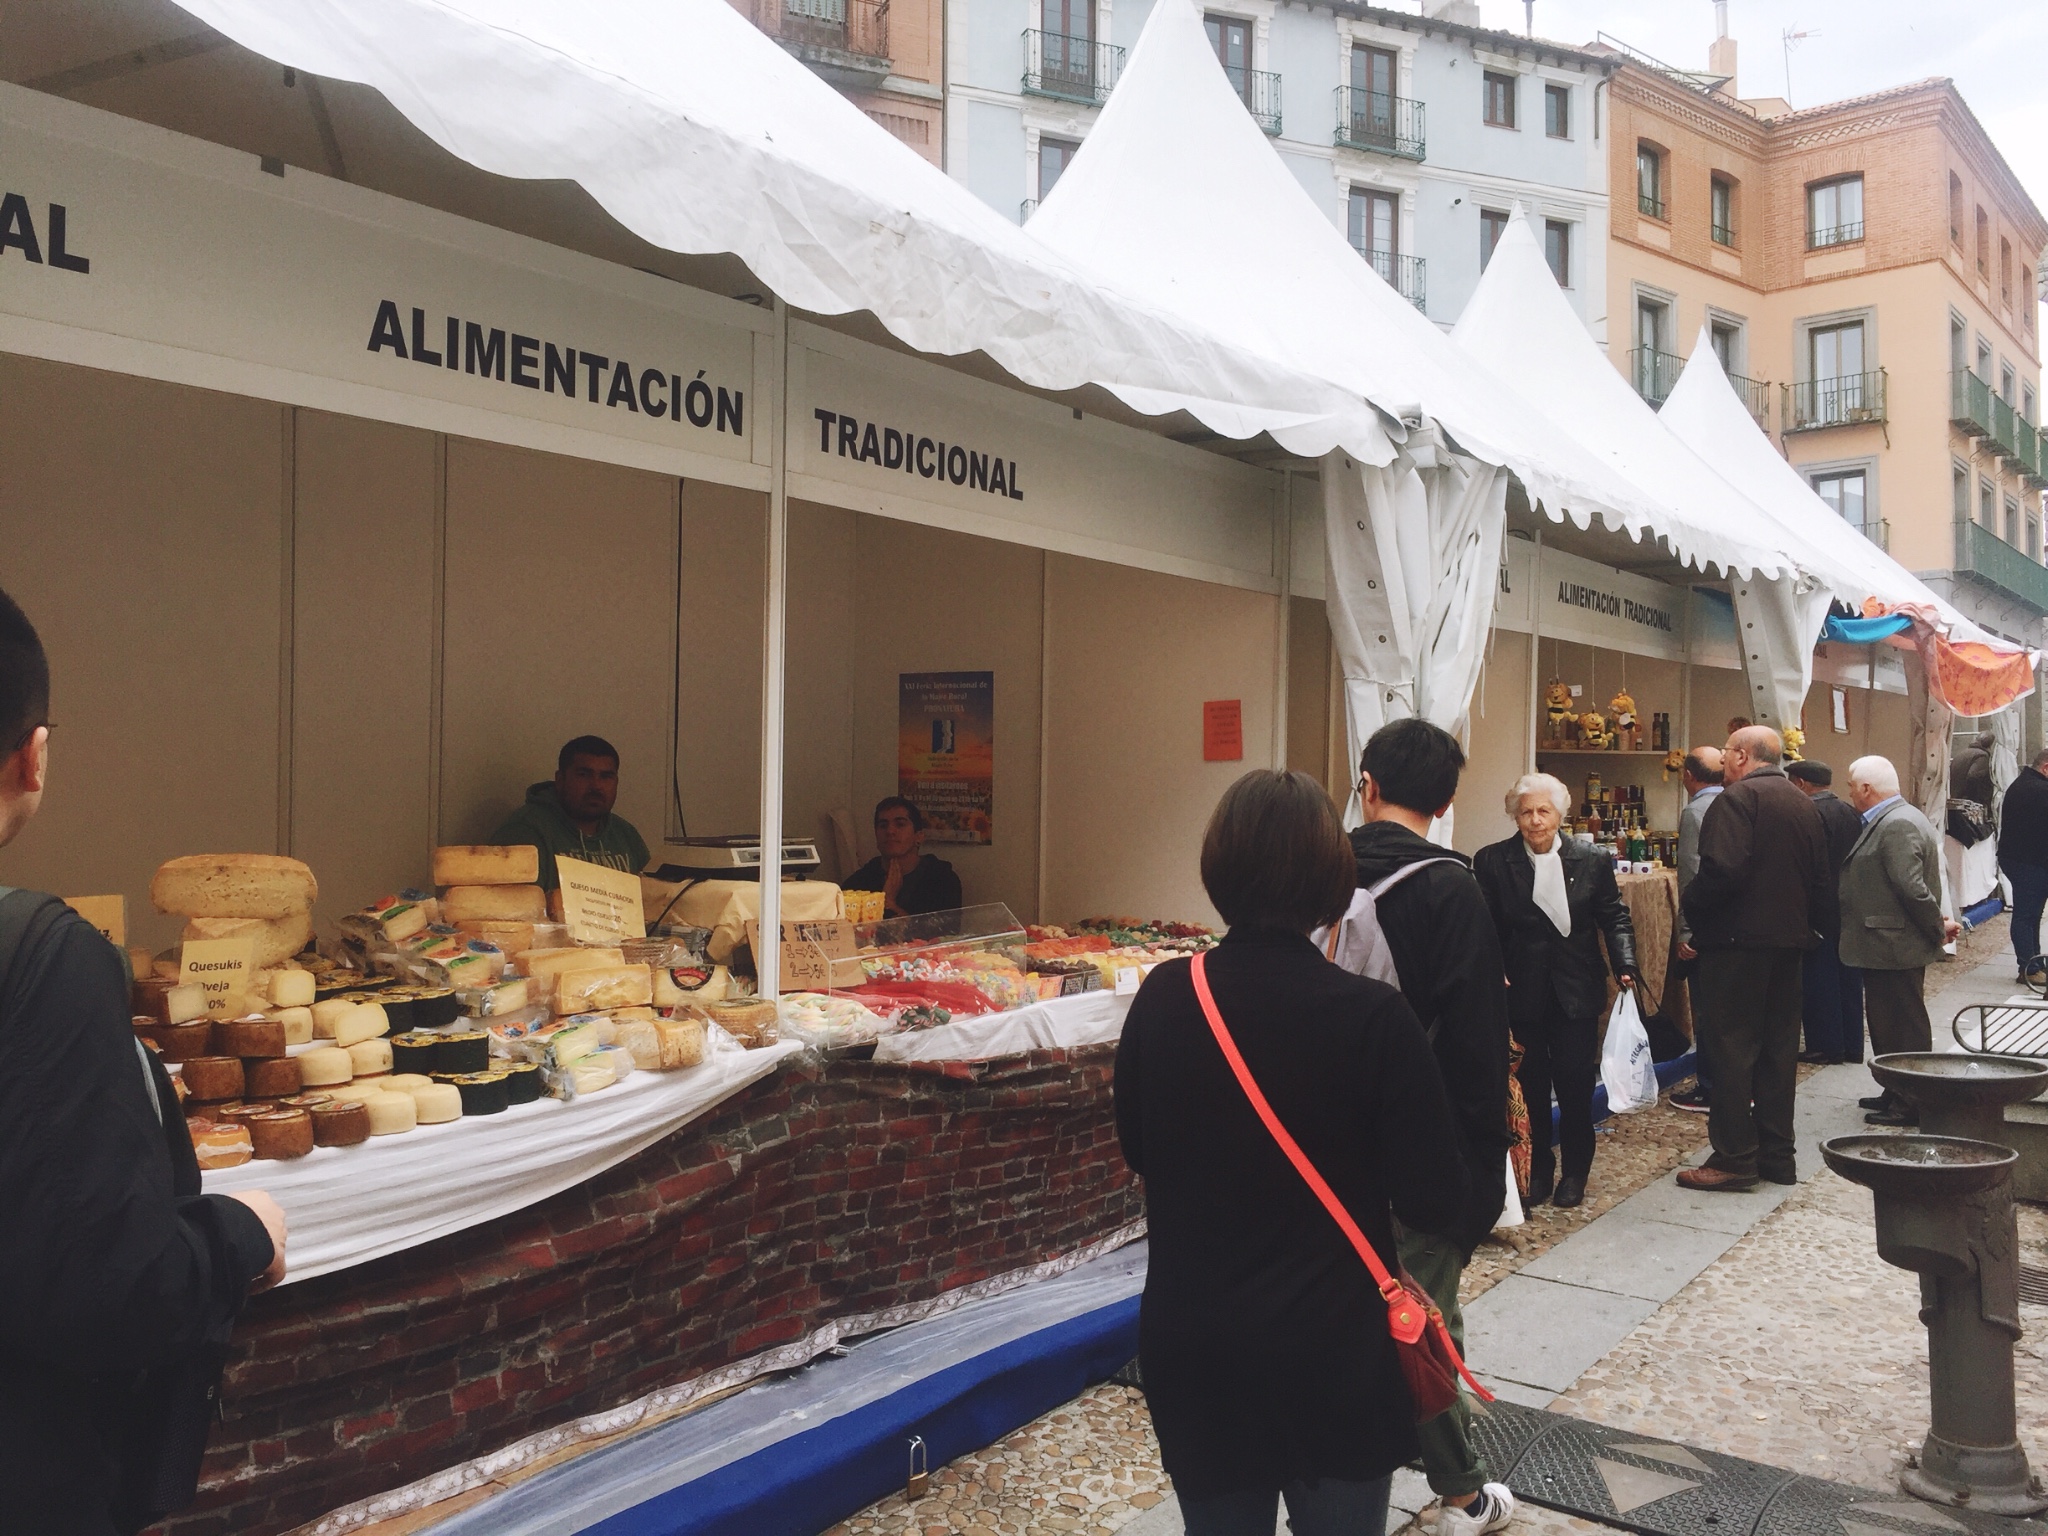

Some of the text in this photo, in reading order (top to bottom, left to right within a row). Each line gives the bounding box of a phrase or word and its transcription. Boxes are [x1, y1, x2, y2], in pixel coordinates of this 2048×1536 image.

[367, 299, 1024, 501] ALIMENTACIÓN TRADICIONAL
[1557, 581, 1672, 632] ALIMENTACIÓN TRADICIONAL
[933, 681, 977, 690] Internacional
[570, 881, 589, 893] QUESO
[188, 959, 243, 973] Quesukis
[207, 998, 226, 1010] 0%
